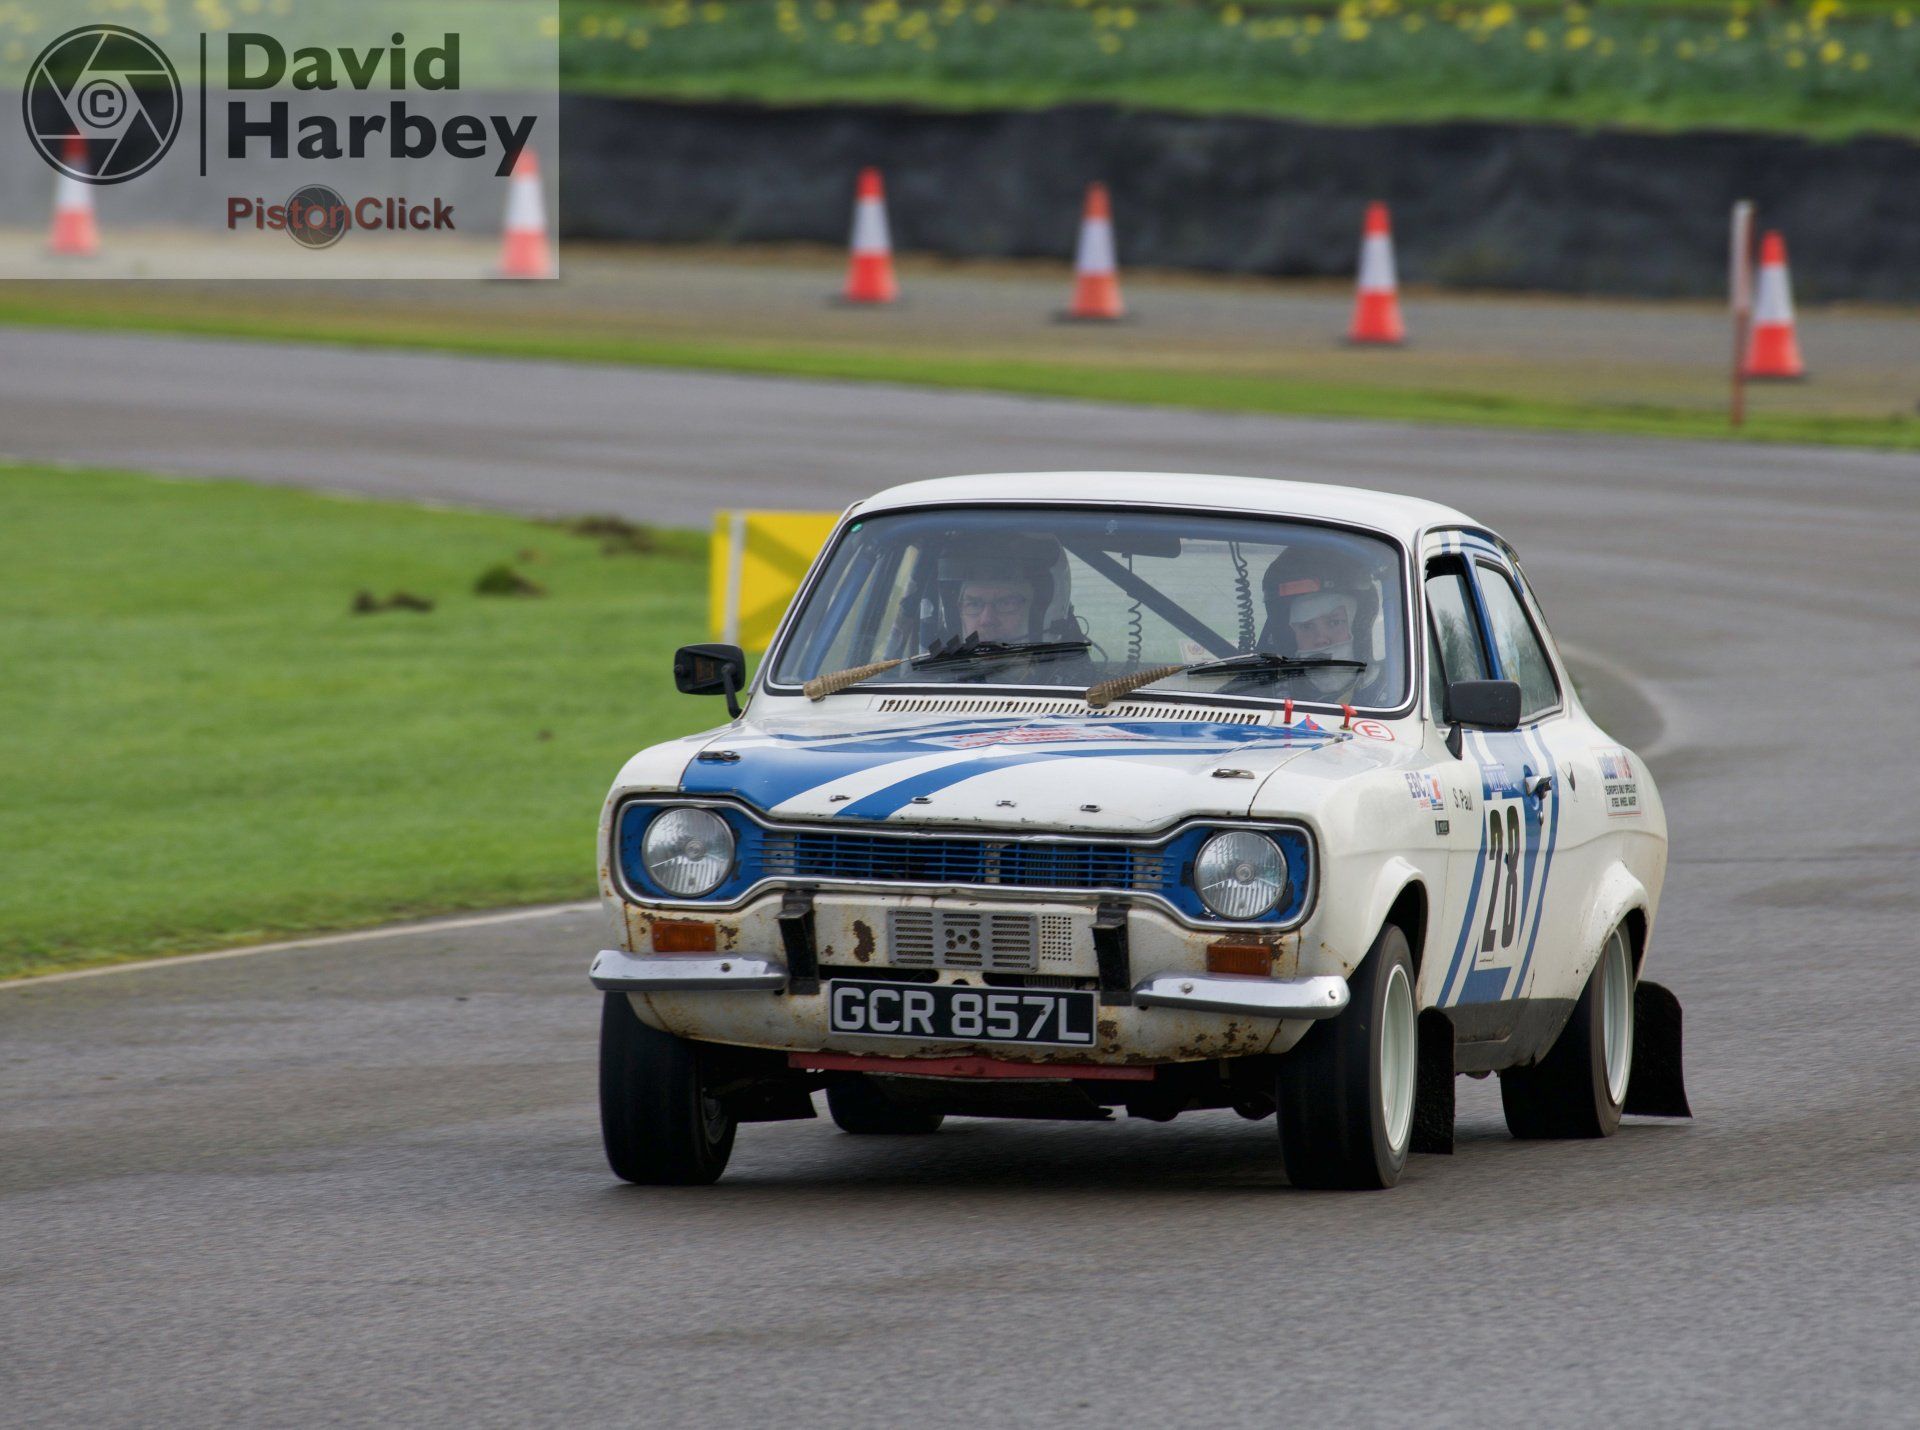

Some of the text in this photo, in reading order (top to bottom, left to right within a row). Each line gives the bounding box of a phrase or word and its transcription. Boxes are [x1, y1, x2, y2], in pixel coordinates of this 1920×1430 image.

[1361, 725, 1387, 739] E
[1459, 789, 1473, 812] Paul
[1481, 805, 1520, 953] 28
[833, 987, 1090, 1042] GCR 857L
